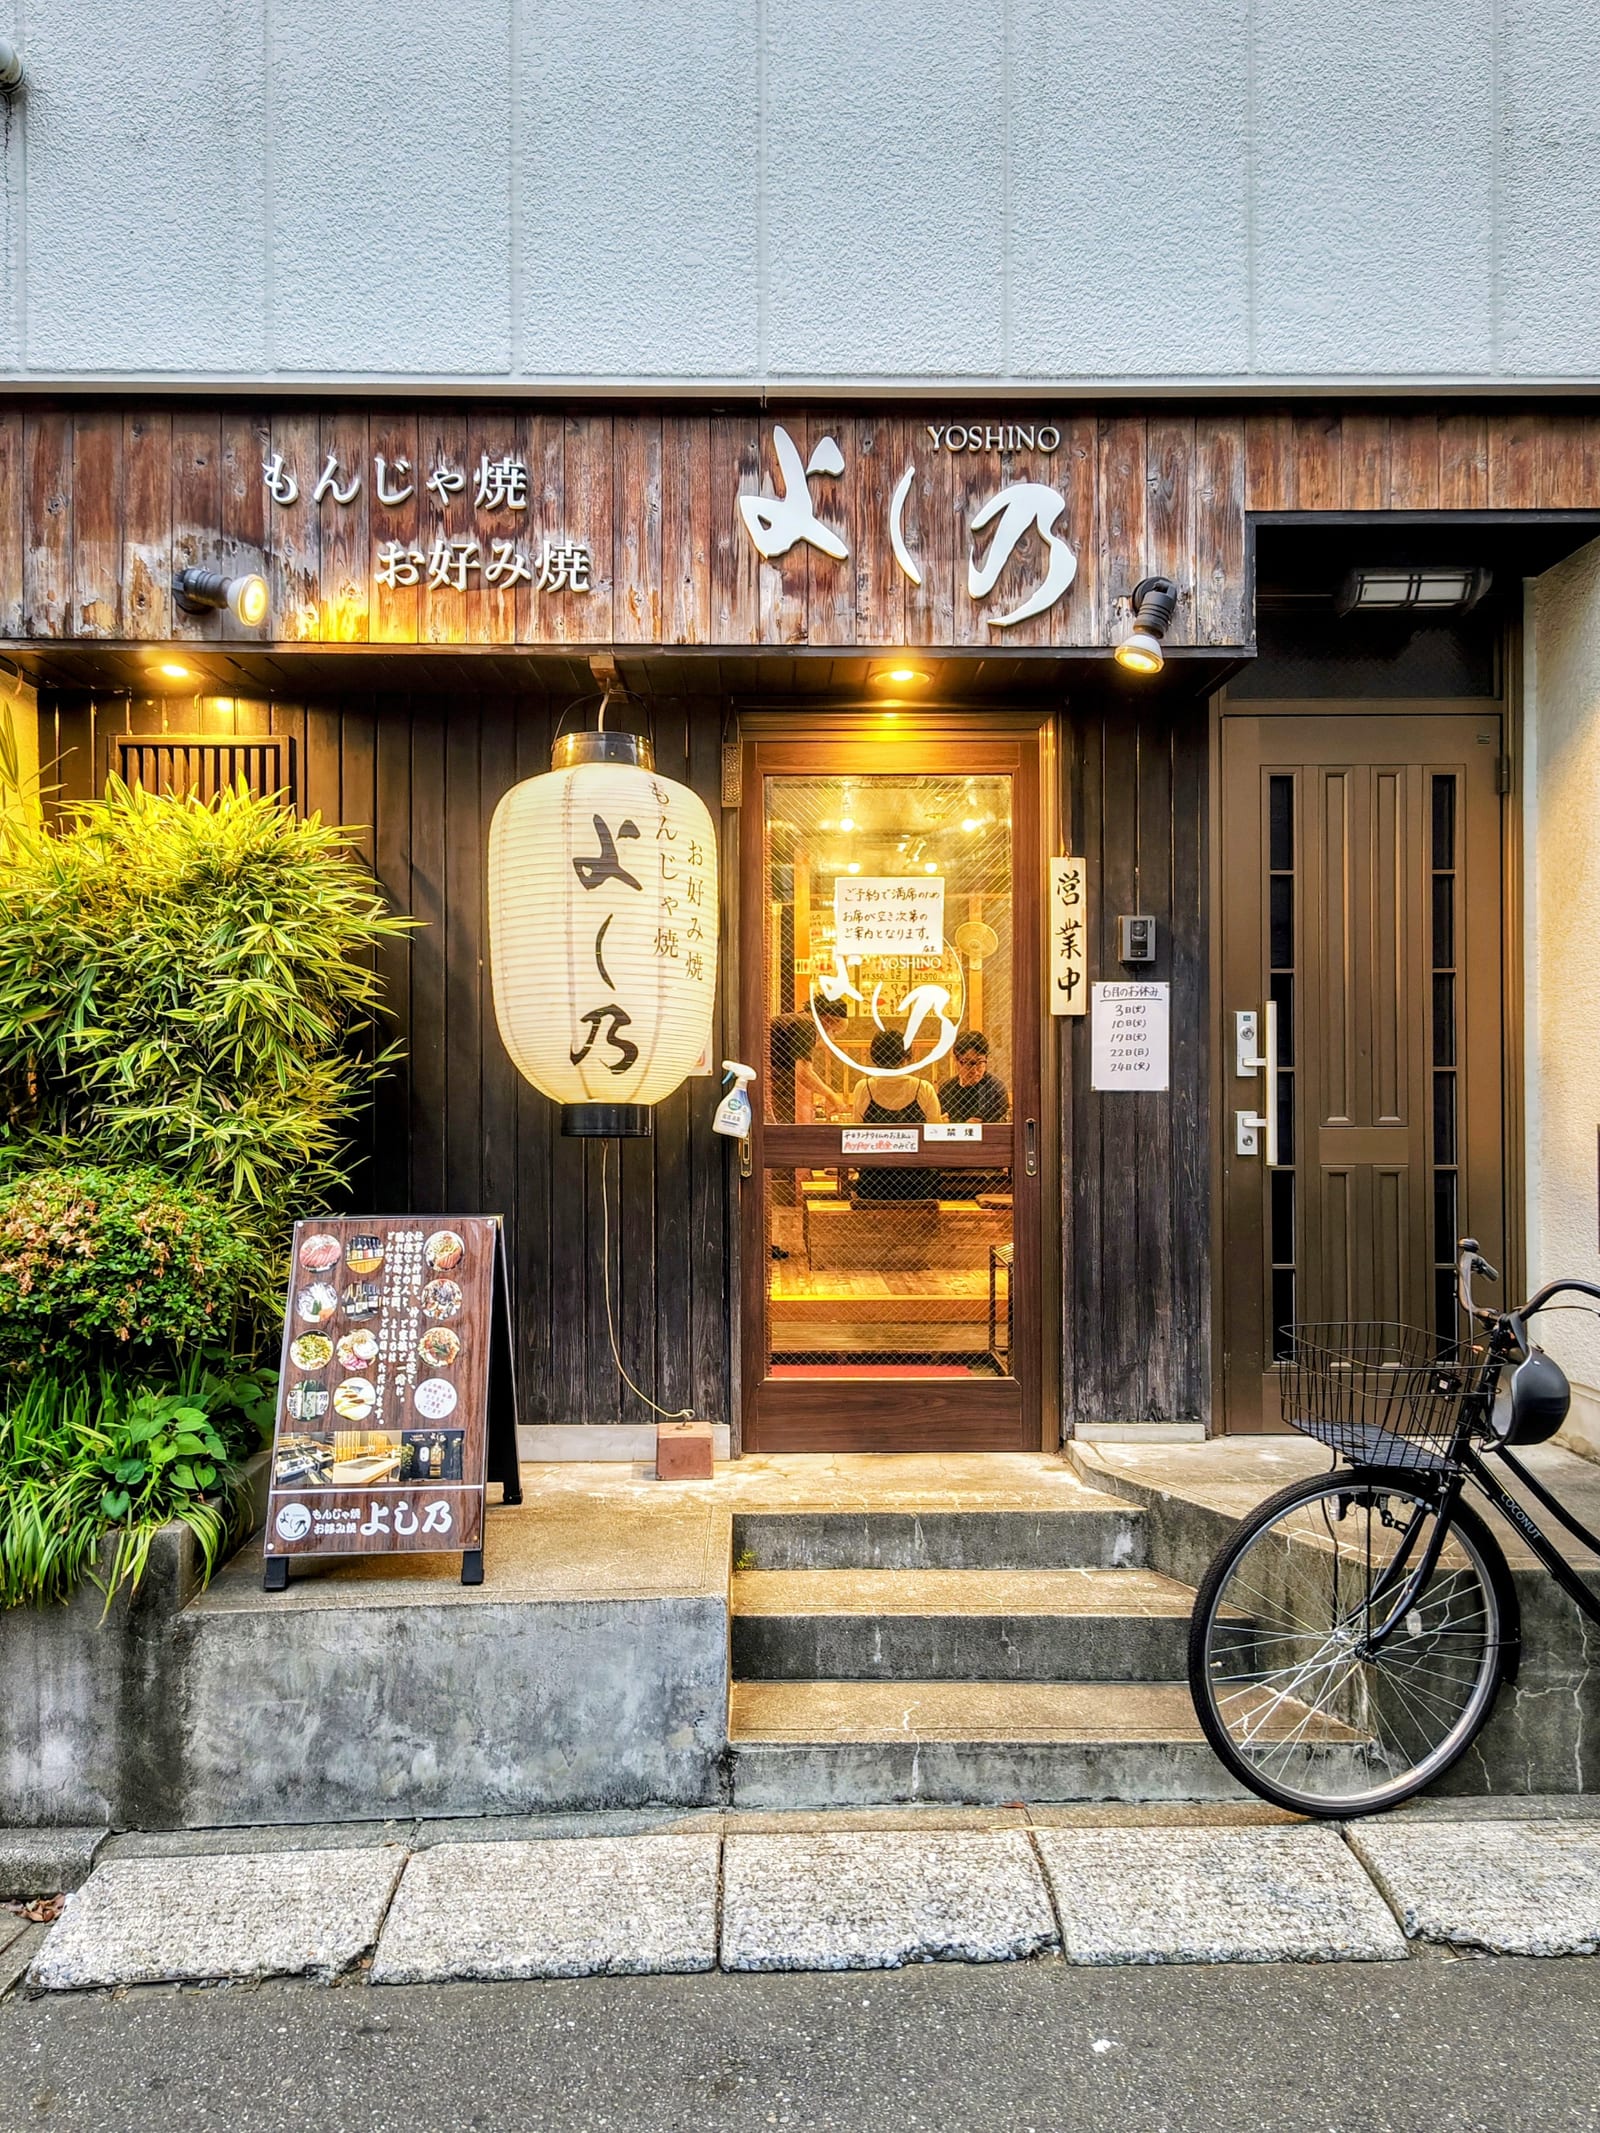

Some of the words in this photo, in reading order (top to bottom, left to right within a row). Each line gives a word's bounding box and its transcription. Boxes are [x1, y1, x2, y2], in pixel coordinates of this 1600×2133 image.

[927, 425, 1061, 452] YOSHINO
[261, 454, 528, 510] もんじゃ焼
[739, 424, 1078, 627] よし乃
[374, 540, 591, 593] お好み焼
[650, 781, 680, 959] もんじゃ焼
[844, 886, 941, 902] ご予約で満席のため
[685, 840, 704, 982] お好み焼
[1055, 869, 1082, 1003] 営業中
[572, 813, 643, 1075] よし乃
[880, 956, 942, 970] YOSHINO
[1102, 985, 1159, 999] 6月のお休み
[360, 1500, 453, 1536] よし乃
[1501, 1494, 1542, 1539] COCONUT
